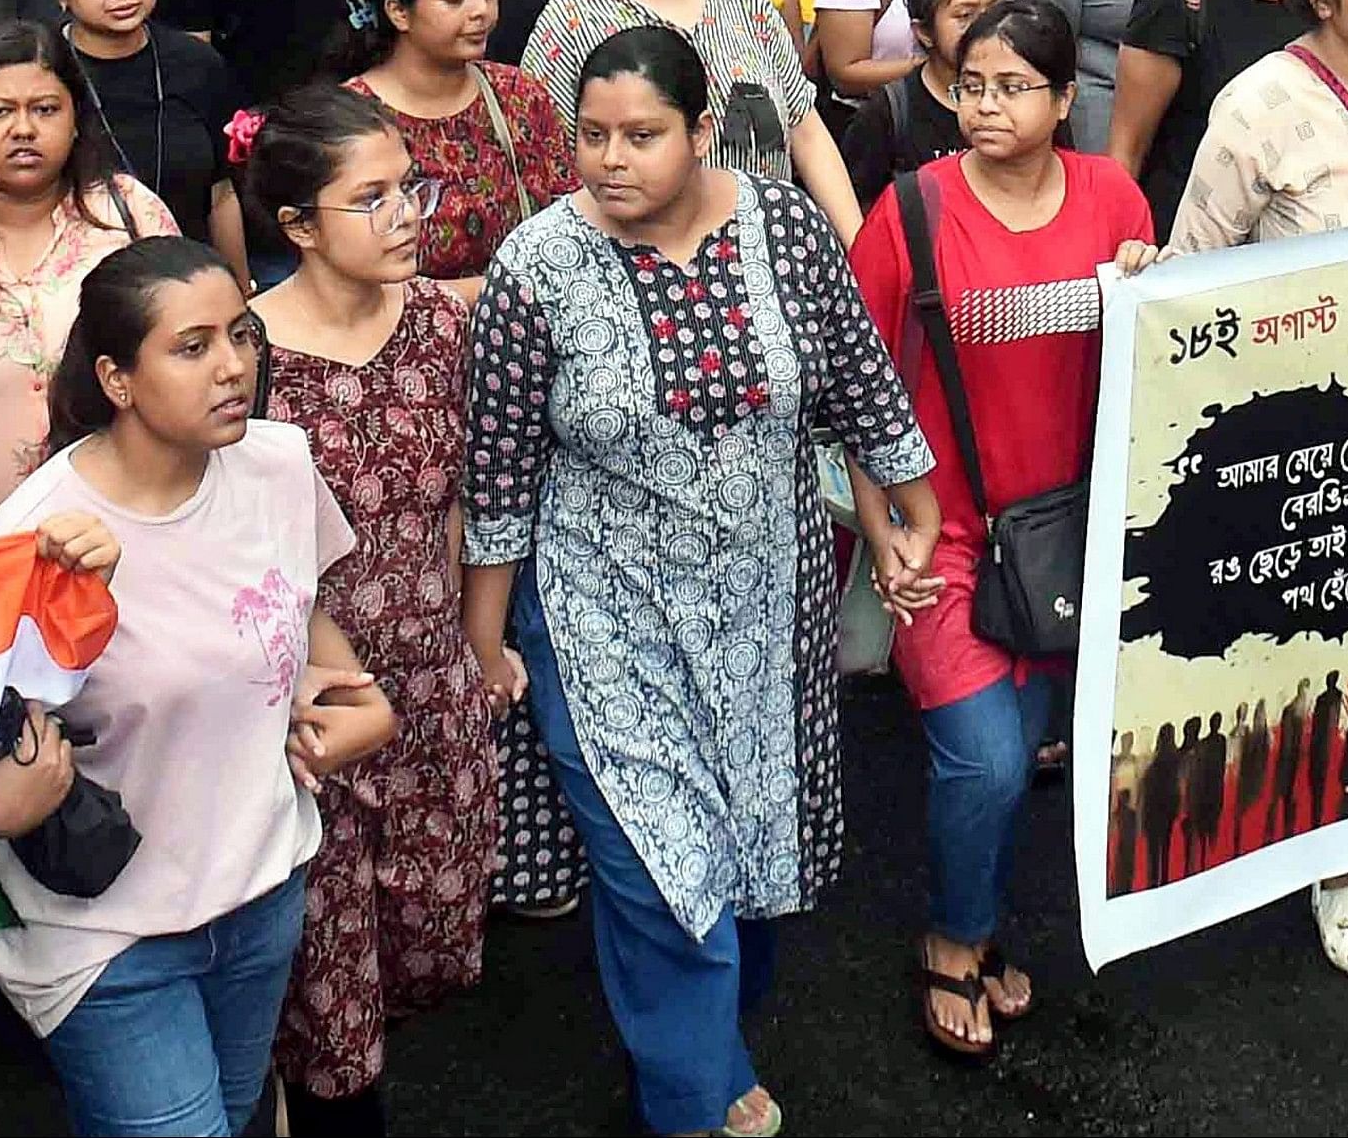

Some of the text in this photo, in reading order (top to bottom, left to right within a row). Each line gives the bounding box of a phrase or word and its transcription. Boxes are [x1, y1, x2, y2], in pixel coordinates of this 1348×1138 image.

[1169, 295, 1338, 364] ১৮ই অগাস্ট
[1216, 454, 1280, 490] আমার
[1286, 442, 1334, 485] মেয়ে
[1208, 556, 1241, 586] রঙ
[1249, 540, 1303, 584] ছেড়ে
[1308, 524, 1347, 559] তাই
[1282, 581, 1315, 612] পথ
